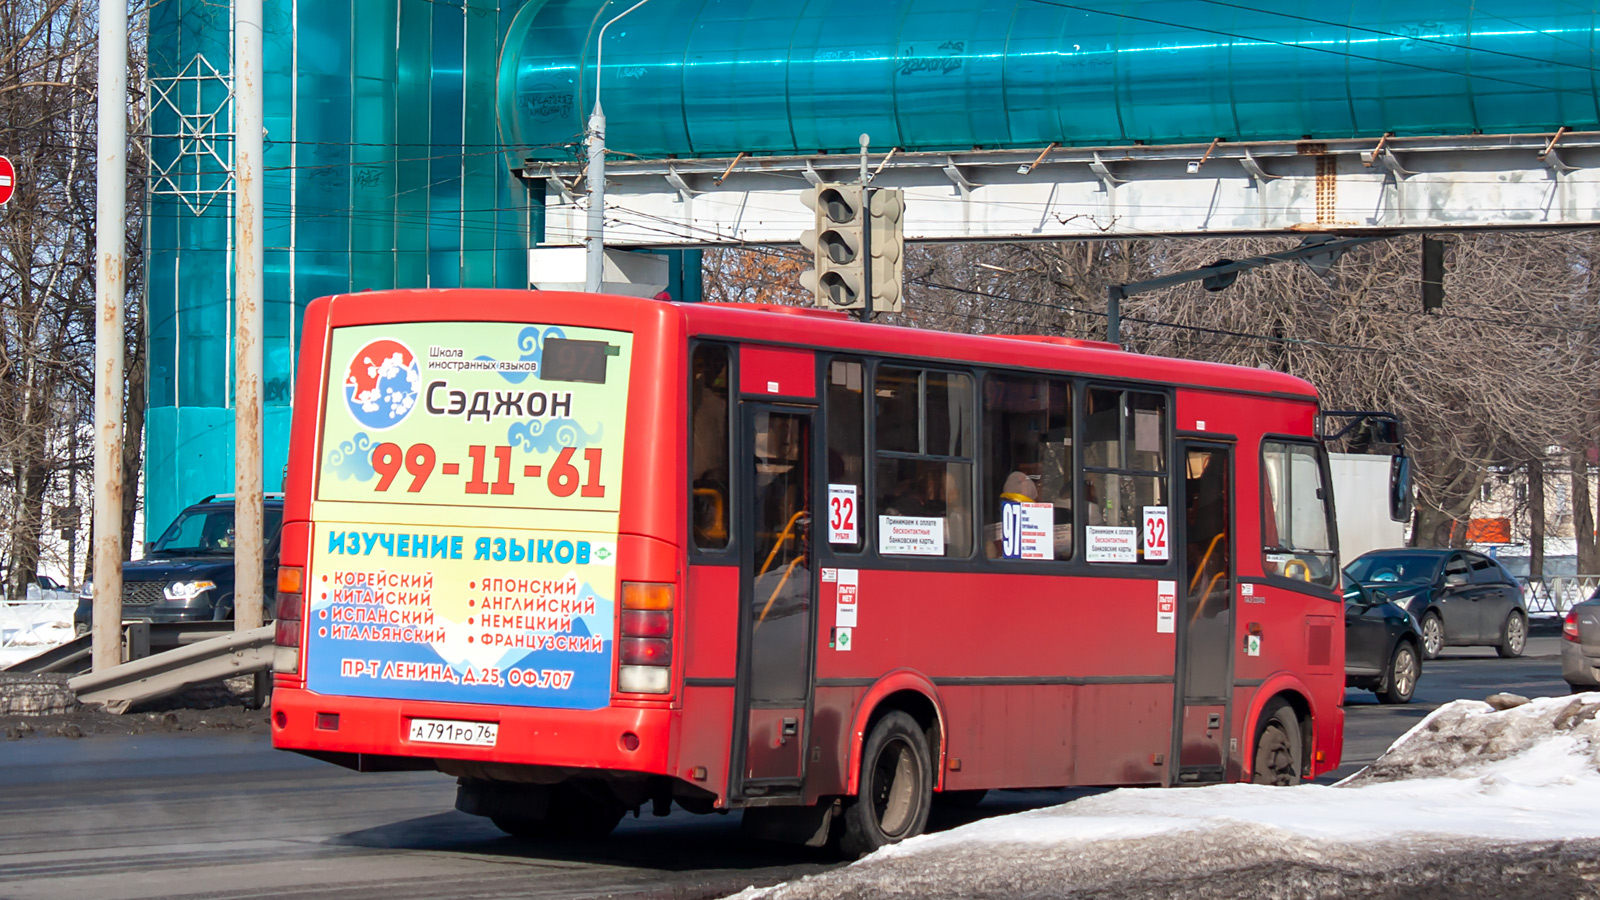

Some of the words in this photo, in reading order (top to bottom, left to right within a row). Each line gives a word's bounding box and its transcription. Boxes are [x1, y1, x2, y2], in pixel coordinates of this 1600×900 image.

[429, 346, 464, 358] Школа
[428, 360, 497, 372] иностранных
[498, 361, 537, 371] языков
[426, 380, 572, 422] Сэджон
[371, 442, 606, 498] 99-11-61
[830, 496, 854, 531] 32
[886, 517, 914, 526] Принимаем
[889, 535, 918, 544] банковские
[892, 526, 931, 535] бесконтактные
[1003, 503, 1021, 557] 97
[1089, 527, 1114, 535] Принимаем
[1094, 535, 1129, 544] бесконтактные
[1146, 517, 1166, 548] 32
[328, 530, 464, 560] ИЗУЧЕНИЕ
[474, 536, 591, 565] ЯЗЫКОВ
[1091, 544, 1118, 553] банковские
[334, 569, 434, 589] КОРЕЙСКИЙ
[481, 577, 577, 596] ЯПОНСКИЙ
[333, 587, 431, 607] КИТАЙСКИЙ
[838, 585, 856, 594] ЛЬГОТ
[842, 594, 853, 603] НЕТ
[480, 594, 595, 615] АНГЛИЙСКИЙ
[331, 607, 434, 625] ИСПАНСКИЙ
[481, 613, 571, 632] НЕМЕЦКИЙ
[331, 625, 446, 644] ИТАЛЬЯНСКИЙ
[480, 632, 603, 652] ФРАНЦУЗСКИЙ
[341, 660, 379, 676] ПР-Т
[383, 663, 458, 682] ЛЕНИНА,
[463, 667, 504, 685] Д.25,
[509, 669, 573, 687] ОФ.707
